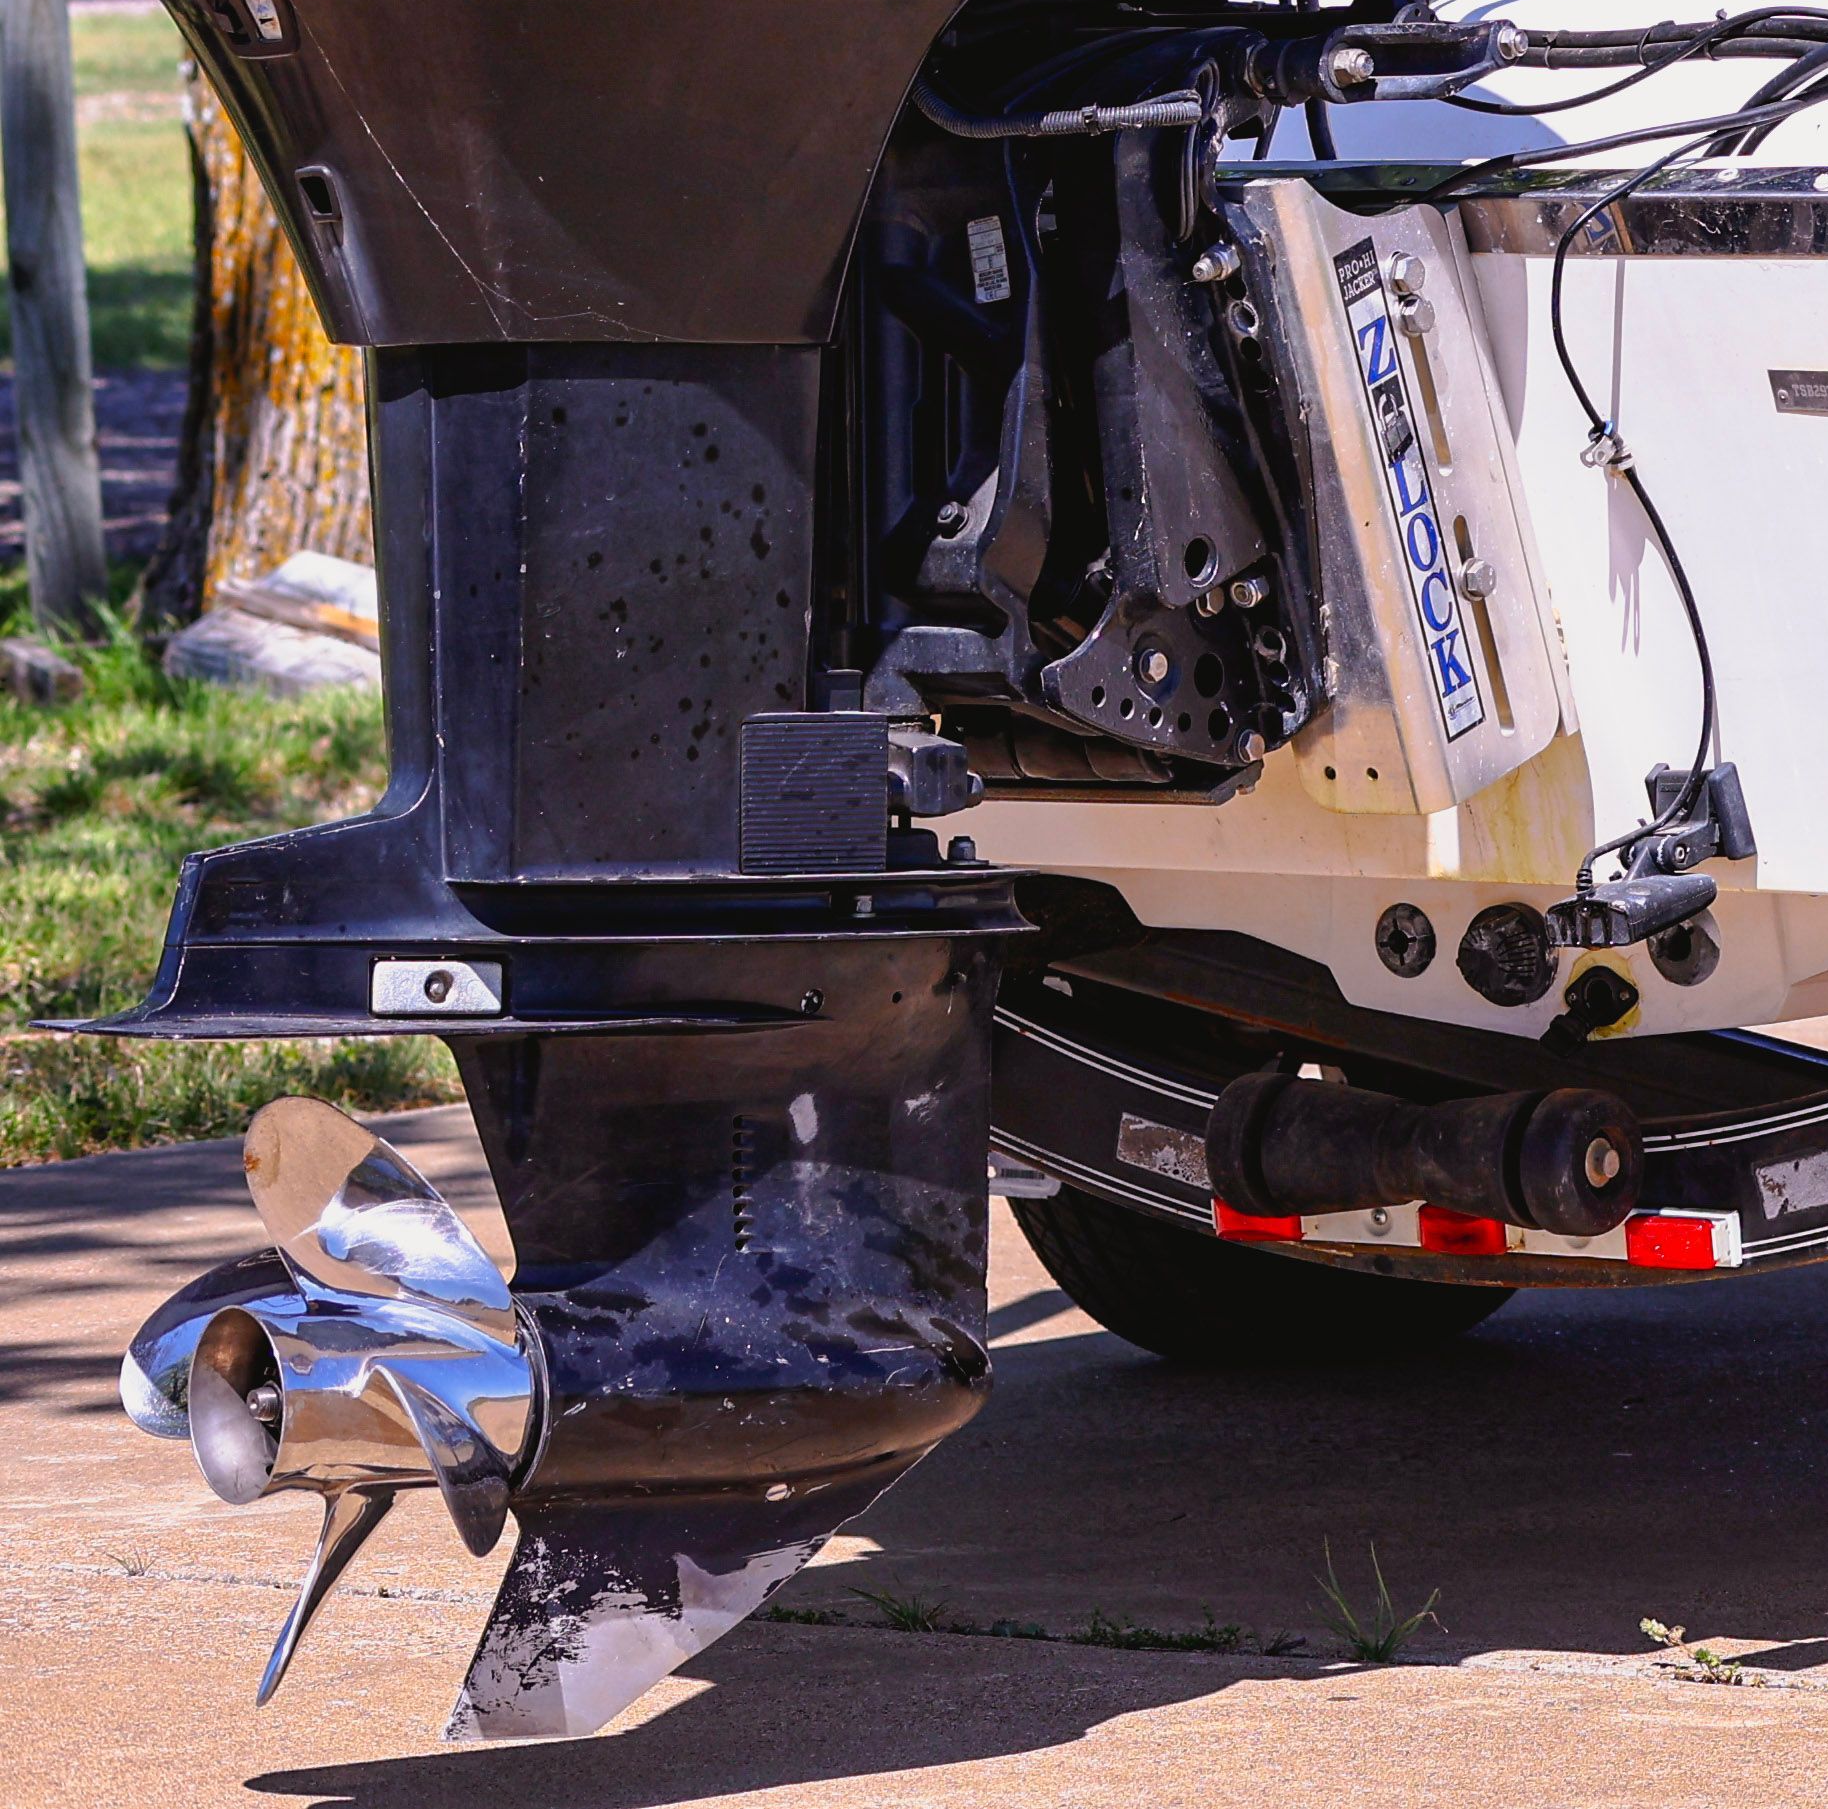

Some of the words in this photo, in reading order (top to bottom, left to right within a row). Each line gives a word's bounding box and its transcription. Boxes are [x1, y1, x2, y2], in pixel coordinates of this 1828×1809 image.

[1343, 270, 1376, 301] JACKER
[1357, 314, 1398, 388] Z
[1387, 453, 1473, 699] LOCK
